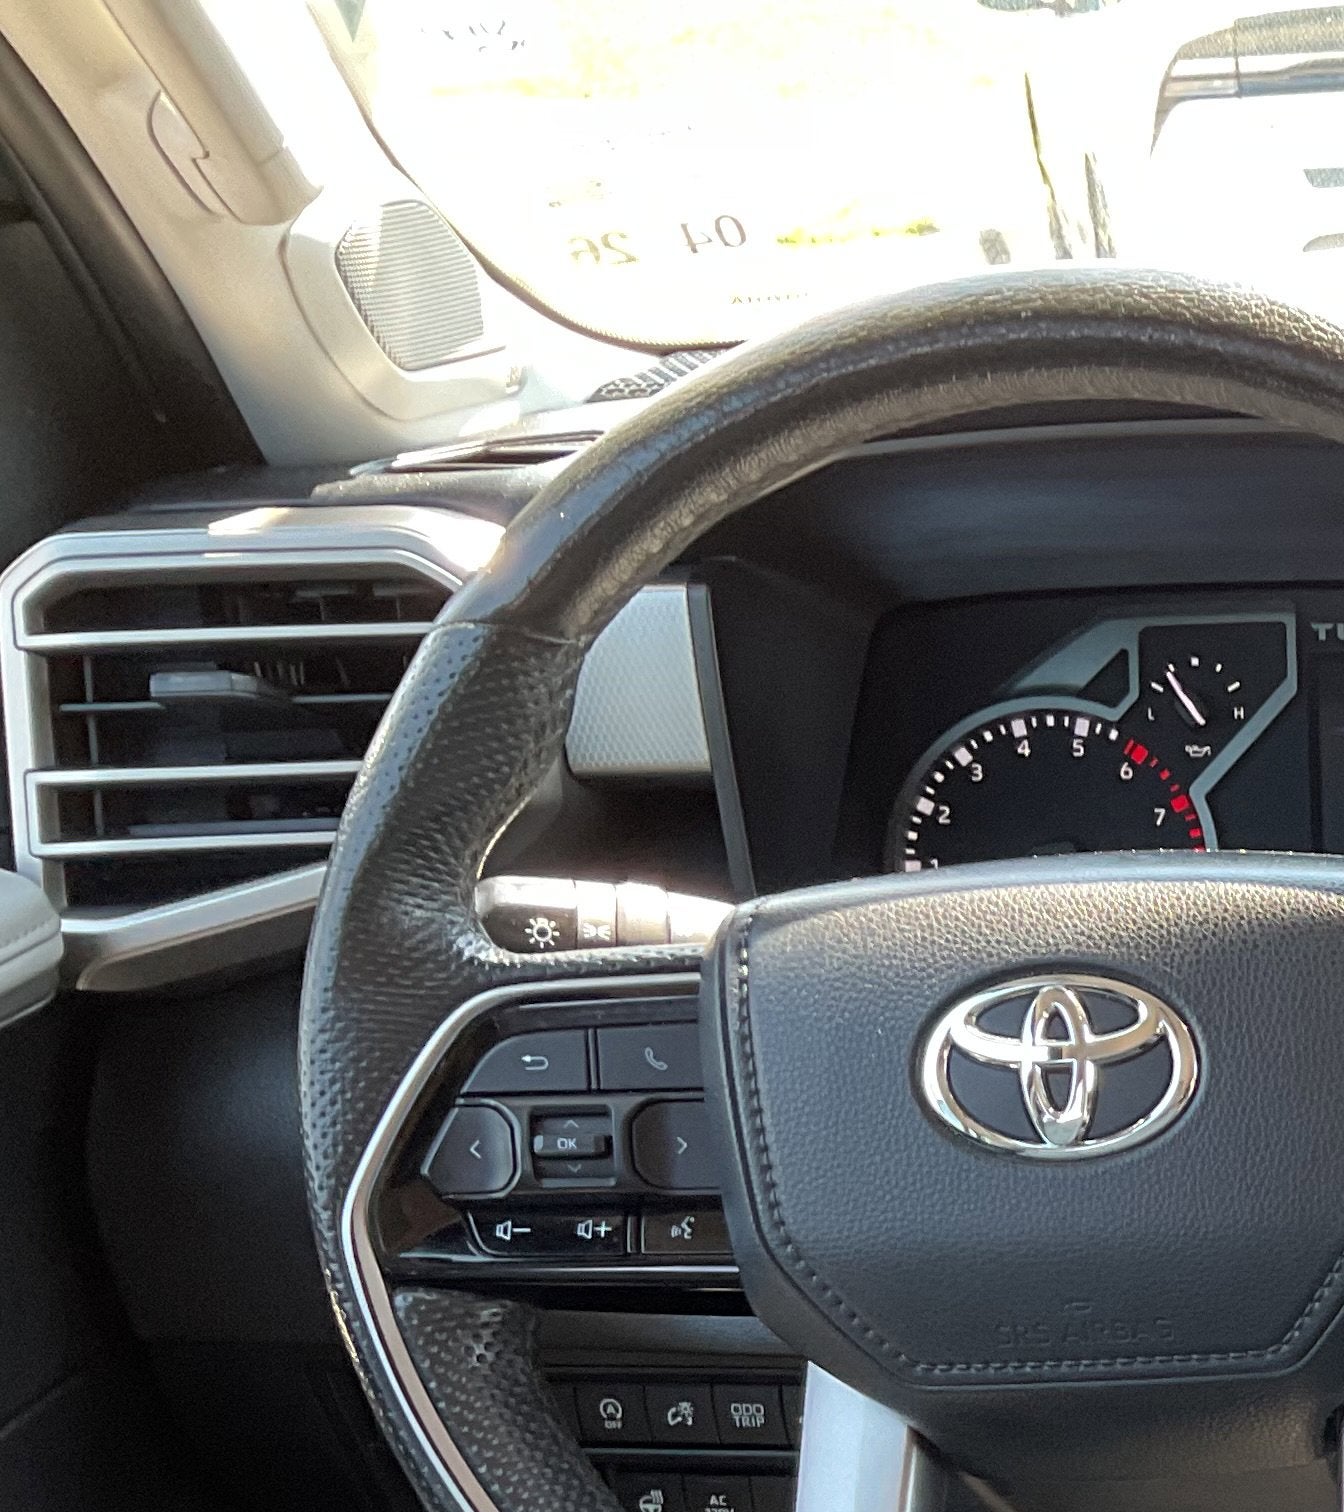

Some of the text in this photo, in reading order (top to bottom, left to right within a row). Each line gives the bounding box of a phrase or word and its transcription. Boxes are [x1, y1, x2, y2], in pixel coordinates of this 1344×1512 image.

[1147, 707, 1155, 721] L
[1233, 706, 1245, 720] H
[1017, 739, 1031, 757] 4
[1072, 739, 1085, 758] 5
[971, 764, 983, 782] 3
[1119, 762, 1134, 780] 6
[938, 805, 951, 824] 2
[1154, 808, 1166, 826] 7
[557, 1137, 577, 1150] OK
[731, 1402, 764, 1416] ODO
[733, 1415, 765, 1428] TRIP
[709, 1494, 728, 1507] AC
